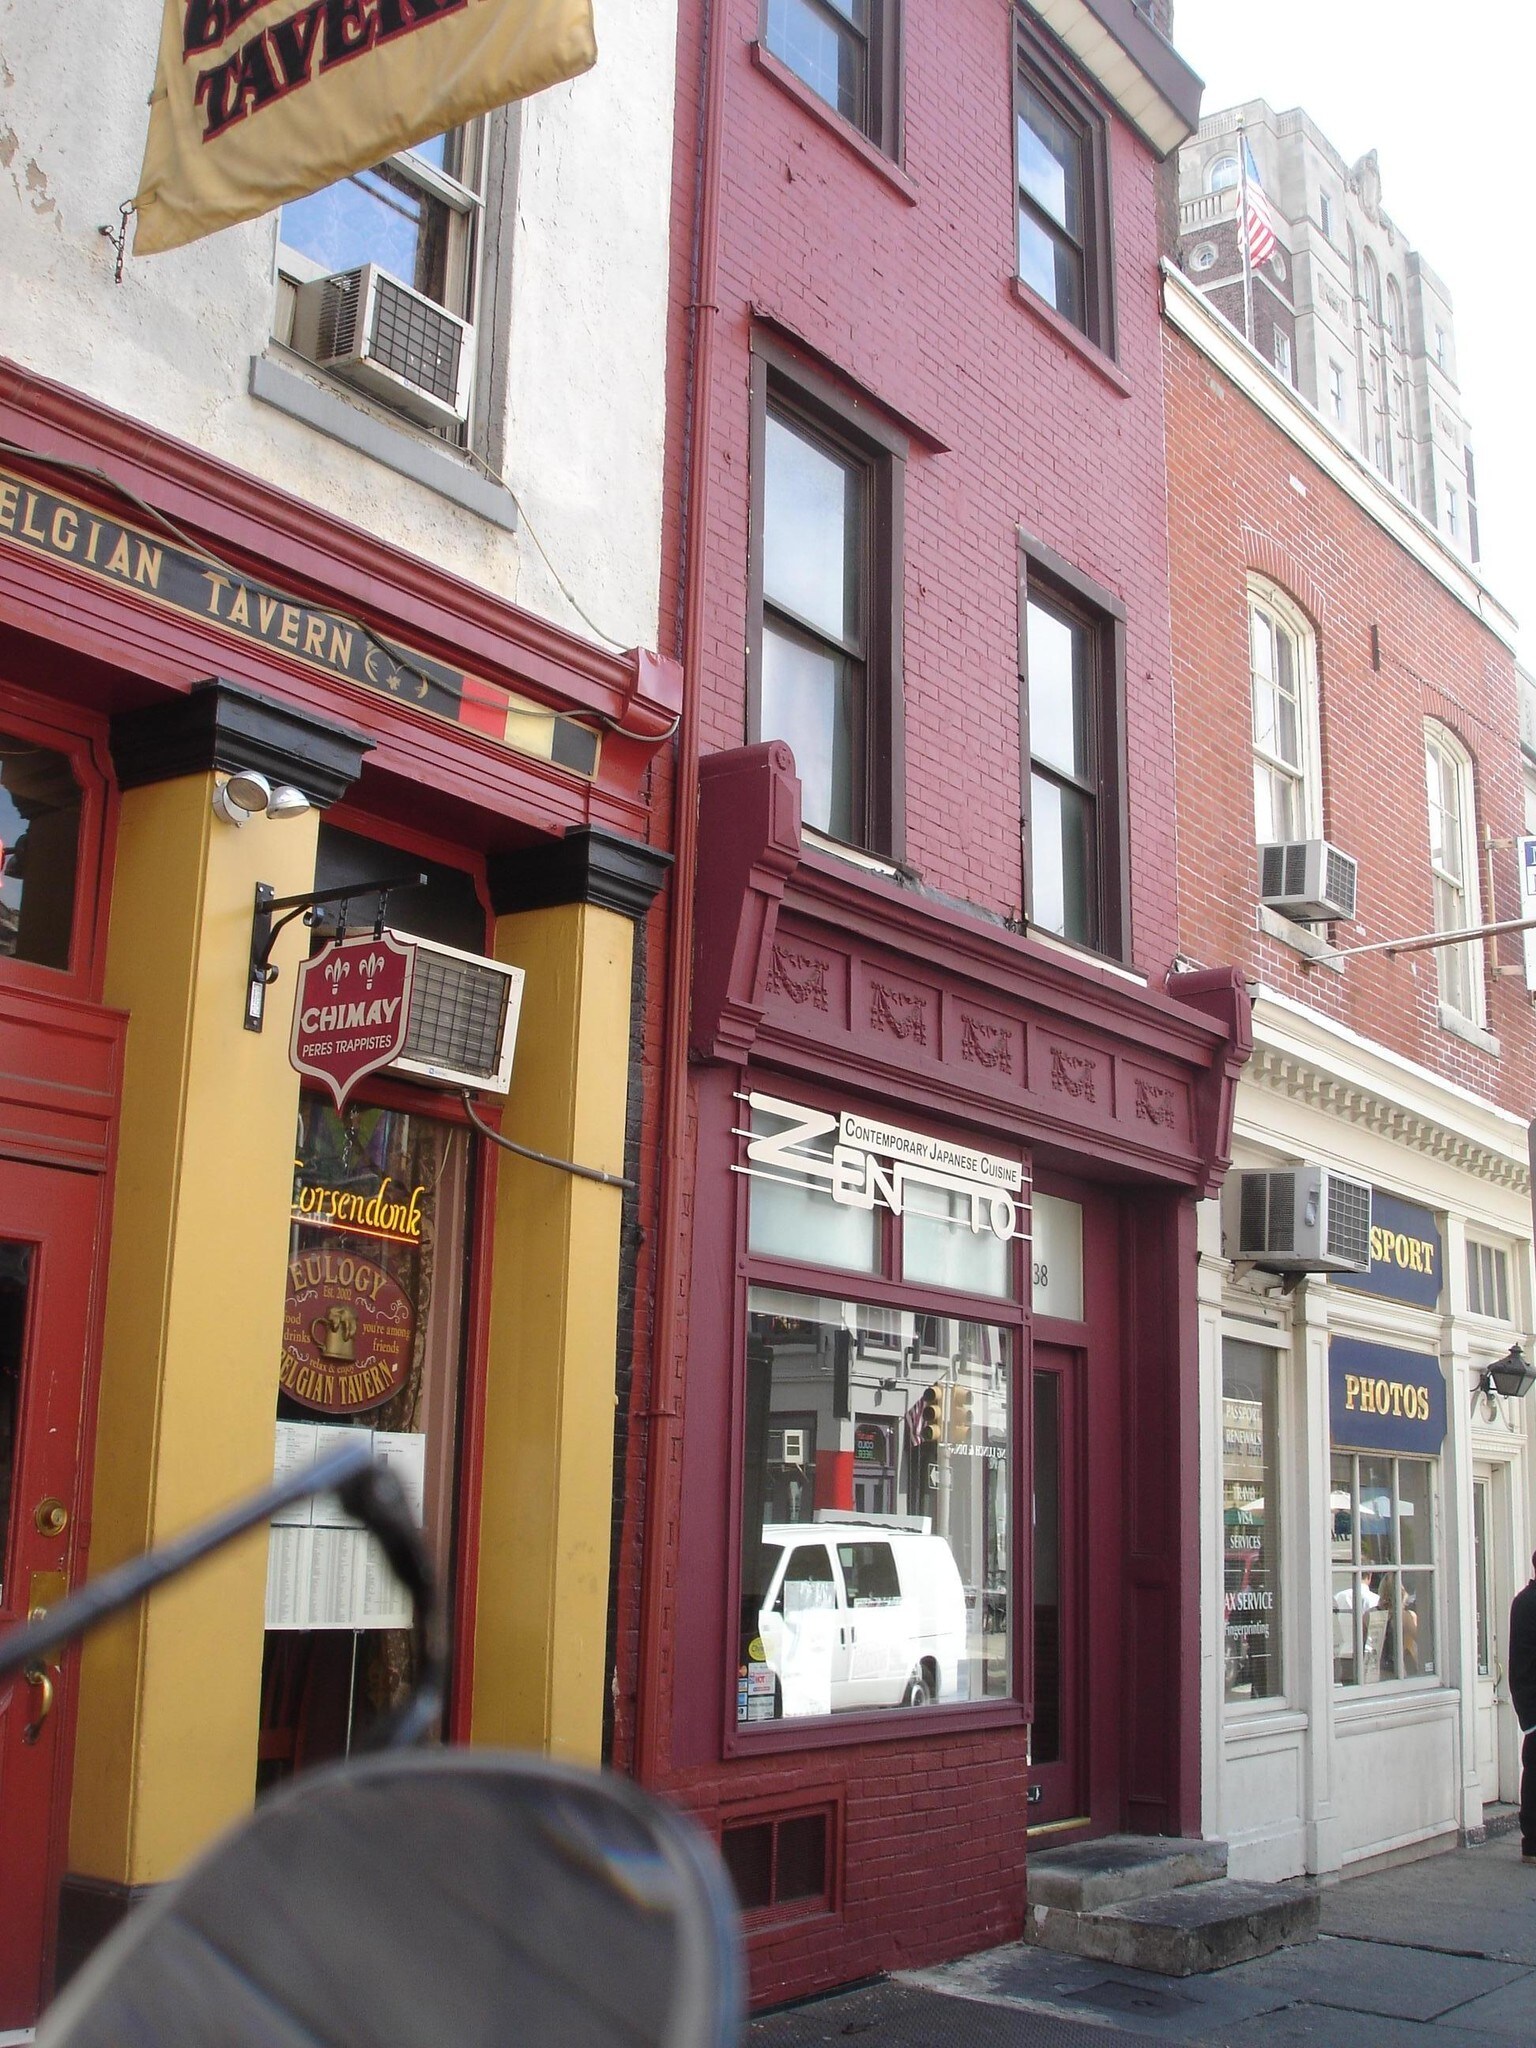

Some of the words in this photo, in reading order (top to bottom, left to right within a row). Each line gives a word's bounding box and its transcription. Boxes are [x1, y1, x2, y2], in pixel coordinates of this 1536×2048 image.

[201, 570, 353, 671] TAVERN
[300, 996, 402, 1034] CHIMAY
[302, 1041, 333, 1058] PERES
[335, 1034, 392, 1055] TRAPPISTES
[289, 1254, 388, 1301] EULOGY
[283, 1311, 302, 1325] ood
[284, 1328, 311, 1344] drinks
[362, 1320, 386, 1336] you're
[373, 1338, 400, 1354] friends
[309, 1357, 327, 1373] relax
[339, 1358, 393, 1404] TAVERN
[1344, 1373, 1430, 1421] PHOTOS
[1226, 1429, 1262, 1446] RENEWALS
[1237, 1510, 1254, 1525] VISA
[1230, 1534, 1261, 1549] SERVICES
[1237, 1591, 1274, 1611] SERVICE
